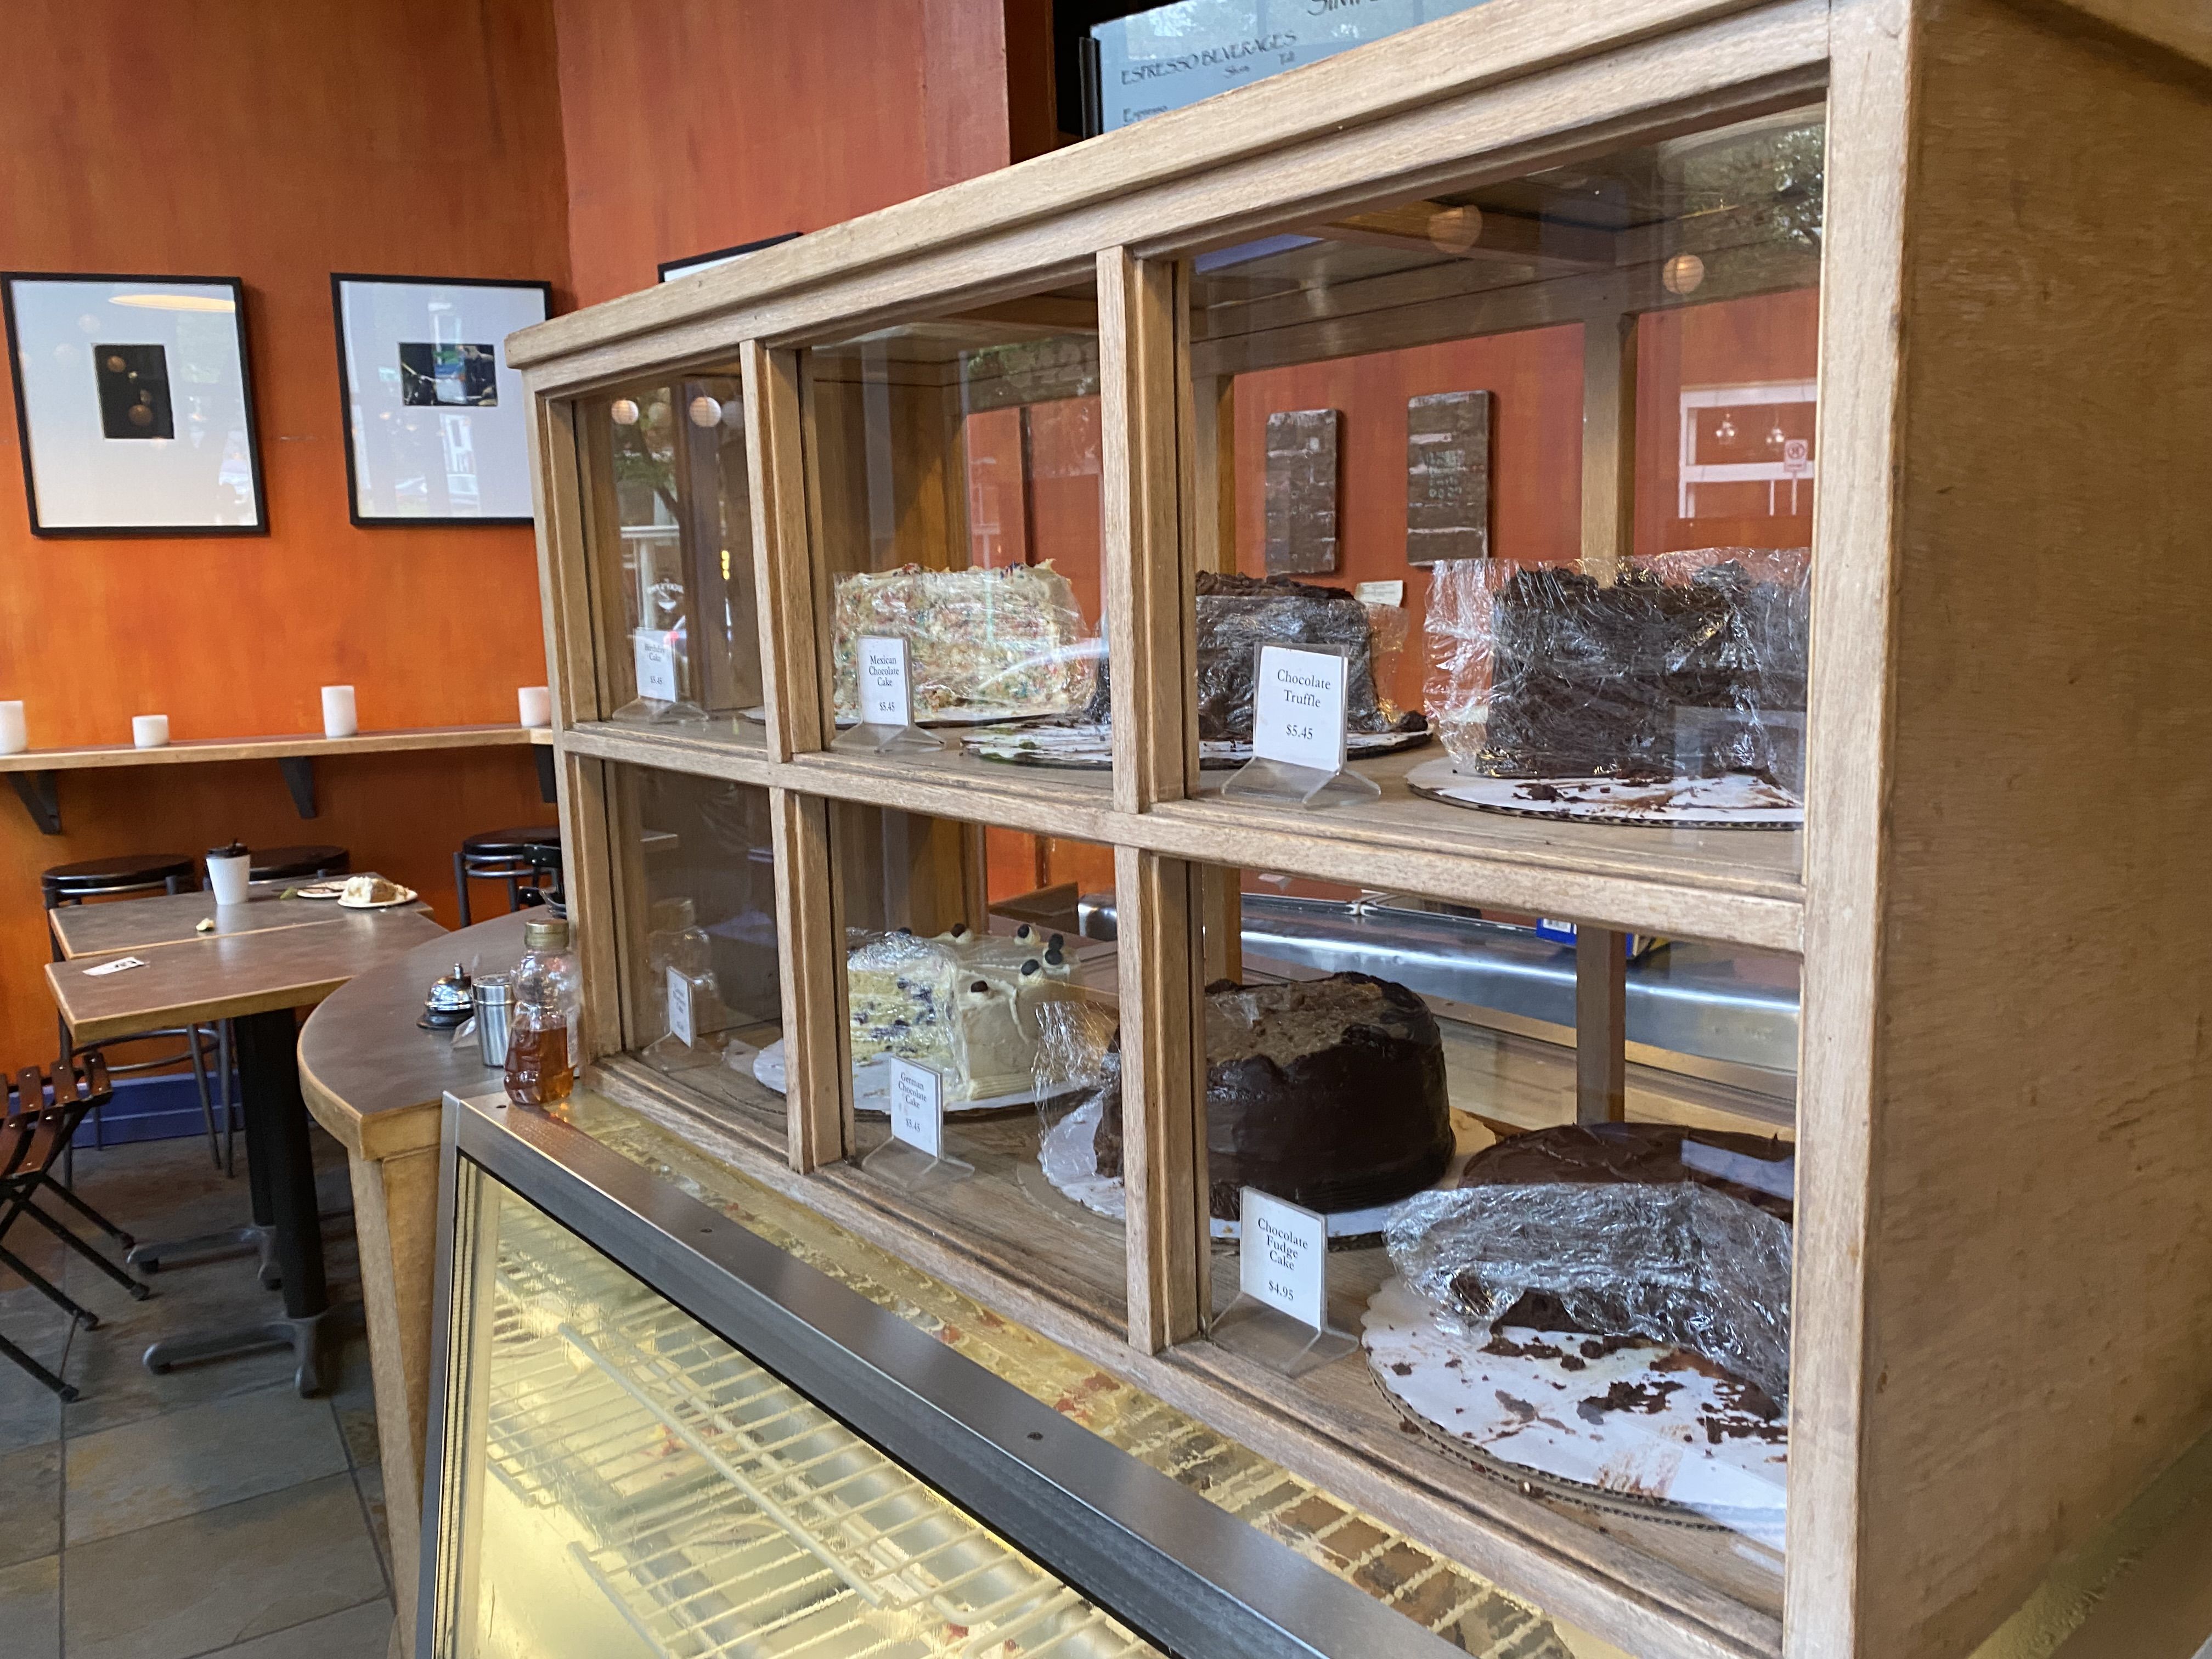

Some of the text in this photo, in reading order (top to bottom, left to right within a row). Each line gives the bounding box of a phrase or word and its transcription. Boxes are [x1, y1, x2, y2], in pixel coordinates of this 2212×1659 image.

[1121, 32, 1297, 85] ESPRESSO BEVERAGES
[649, 652, 662, 662] Cake
[870, 654, 897, 665] Mexican
[868, 665, 899, 676] Chocolate
[1277, 668, 1331, 690] Chocolate
[877, 676, 893, 686] Cake
[879, 701, 895, 713] $5.45
[1284, 689, 1321, 708] Truffle
[1286, 724, 1313, 740] $5.45
[901, 1071, 924, 1091] German
[898, 1080, 927, 1102] Chocolate
[905, 1094, 921, 1109] Cake
[1258, 1217, 1308, 1250] Chocolate
[1267, 1234, 1299, 1260] Fudge
[1269, 1250, 1295, 1271] Cake
[1268, 1279, 1294, 1301] $4.95
